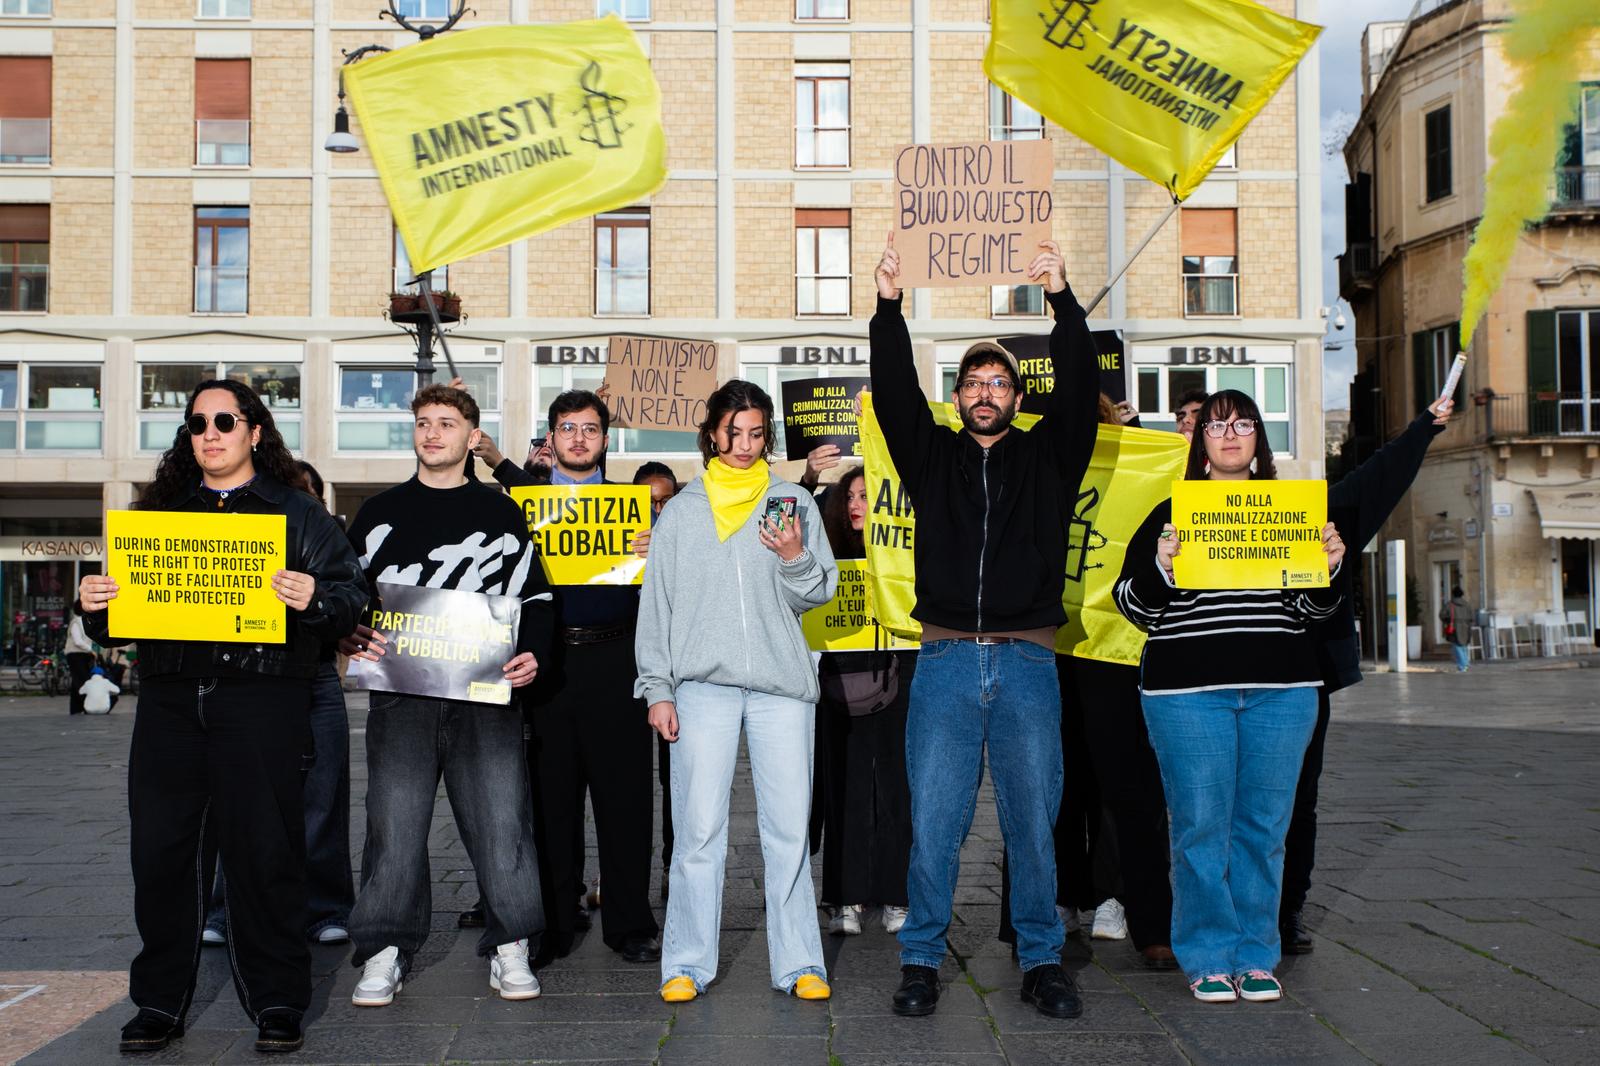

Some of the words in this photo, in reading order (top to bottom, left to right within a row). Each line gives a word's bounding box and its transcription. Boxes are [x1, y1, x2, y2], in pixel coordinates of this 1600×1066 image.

[412, 93, 557, 169] AMNESTY
[421, 136, 572, 198] INTERNATIONAL
[896, 144, 992, 189] CONTRO
[1003, 144, 1024, 184] IL
[900, 189, 948, 229] BUIO
[953, 190, 970, 223] DI
[973, 190, 1053, 224] QUESTO
[928, 232, 1024, 279] REGIME
[559, 346, 608, 364] BN
[608, 337, 716, 371] L'ATTIVISMO
[804, 347, 866, 365] BNL
[1194, 346, 1256, 365] BNL
[631, 369, 670, 396] NON
[674, 367, 687, 397] È
[813, 387, 825, 397] NO
[826, 386, 846, 397] ALLA
[605, 396, 634, 423] UN
[640, 397, 708, 428] REATO
[786, 416, 794, 426] DI
[795, 414, 827, 425] PERSONE
[829, 413, 835, 422] E
[803, 425, 858, 437] DISCRIMINATE
[1226, 495, 1242, 507] NO
[1245, 495, 1272, 507] ALLA
[522, 497, 641, 525] GIUSTIZIA
[1192, 512, 1307, 525] CRIMINALIZZAZIONE
[530, 529, 635, 557] GLOBALE
[1179, 530, 1190, 542] DI
[1194, 529, 1246, 542] PERSONE
[1251, 529, 1258, 542] E
[1261, 526, 1320, 542] COMUNITÀ
[115, 537, 160, 551] DURING
[165, 539, 278, 557] DEMONSTRATIONS,
[1208, 547, 1290, 560] DISCRIMINATE
[127, 554, 148, 568] THE
[153, 555, 189, 569] RIGHT
[193, 557, 208, 570] TO
[212, 557, 266, 571] PROTEST
[130, 572, 162, 586] MUST
[167, 573, 182, 586] BE
[187, 573, 262, 589] FACILITATED
[147, 590, 171, 603] AND
[175, 591, 246, 605] PROTECTED
[825, 615, 846, 627] CHE
[397, 636, 480, 663] PUBBLICA
